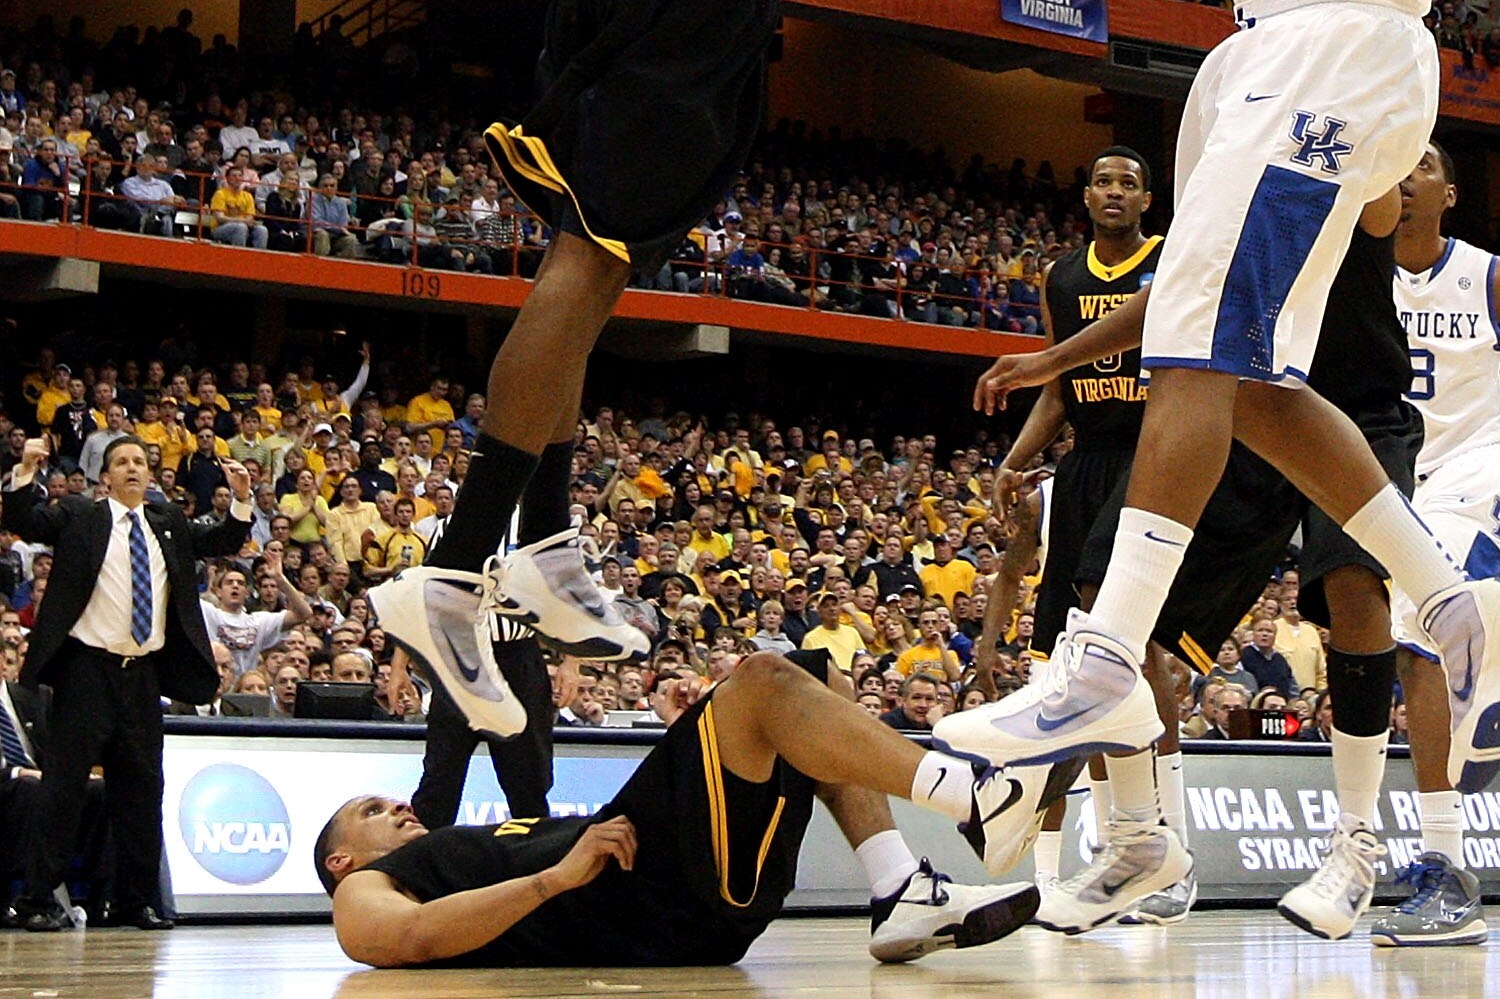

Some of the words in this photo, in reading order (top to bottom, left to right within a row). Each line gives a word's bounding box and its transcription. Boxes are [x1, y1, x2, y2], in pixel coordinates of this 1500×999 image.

[402, 272, 440, 297] 109
[1401, 312, 1479, 338] TUCKY
[1072, 377, 1149, 403] VIRGINIA
[1190, 787, 1295, 831] NCAA
[1297, 790, 1384, 831] EAT
[193, 822, 291, 855] NCAA
[1238, 837, 1386, 876] SYRAC,
